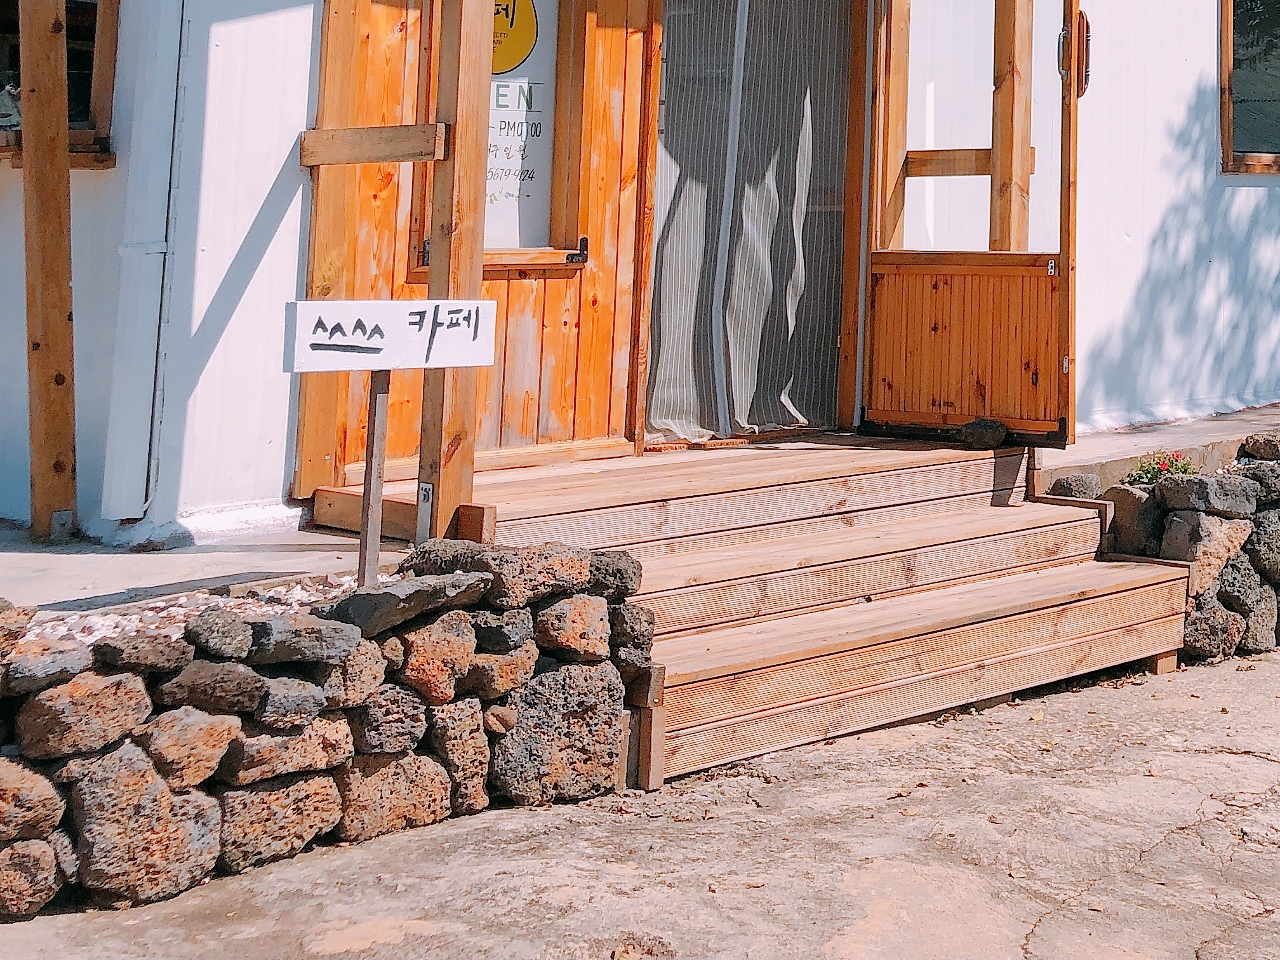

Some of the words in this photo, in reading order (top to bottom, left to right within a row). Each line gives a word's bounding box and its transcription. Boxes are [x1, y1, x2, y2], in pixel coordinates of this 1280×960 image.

[495, 83, 533, 111] EN
[486, 167, 536, 182] 5679-9124
[408, 304, 480, 364] 카페
